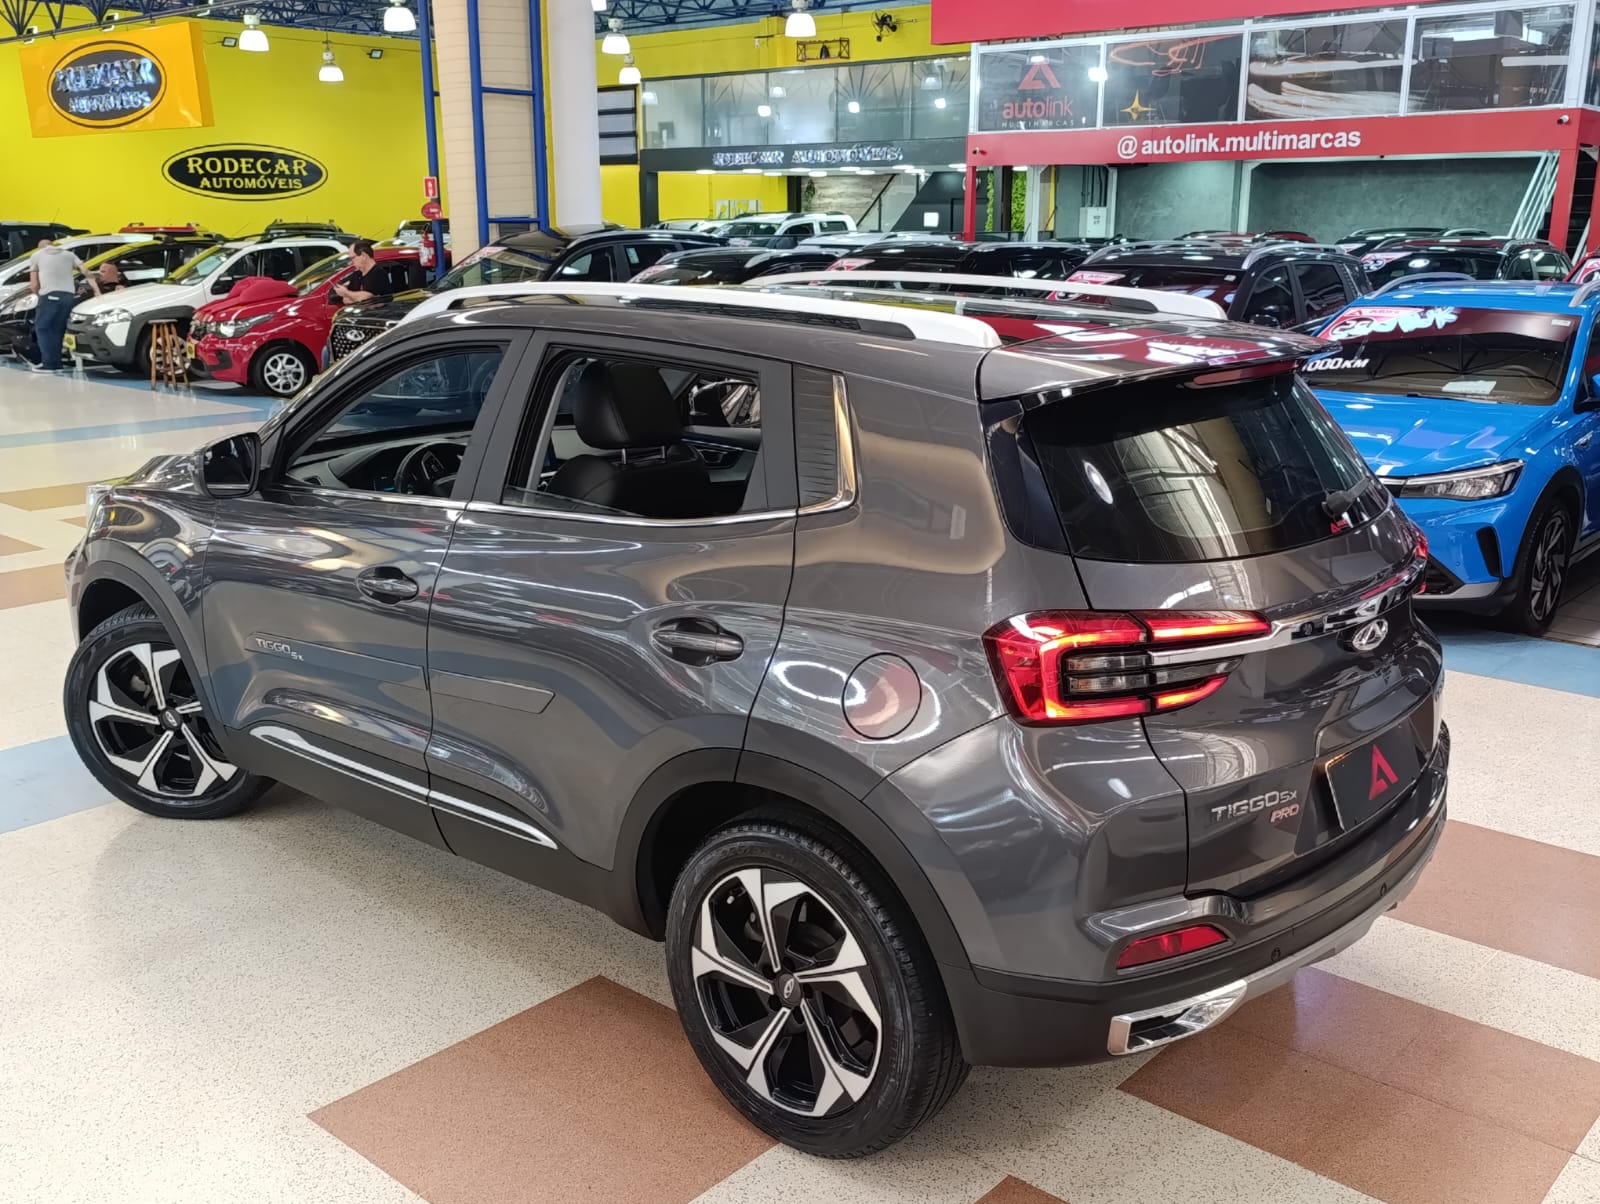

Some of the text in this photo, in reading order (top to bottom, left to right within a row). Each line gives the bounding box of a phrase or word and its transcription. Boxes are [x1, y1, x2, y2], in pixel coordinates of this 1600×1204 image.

[1002, 97, 1073, 119] autolink
[187, 156, 309, 176] RODECAR
[200, 174, 303, 189] AUTOMÓVEIS
[1270, 803, 1300, 823] PRO
